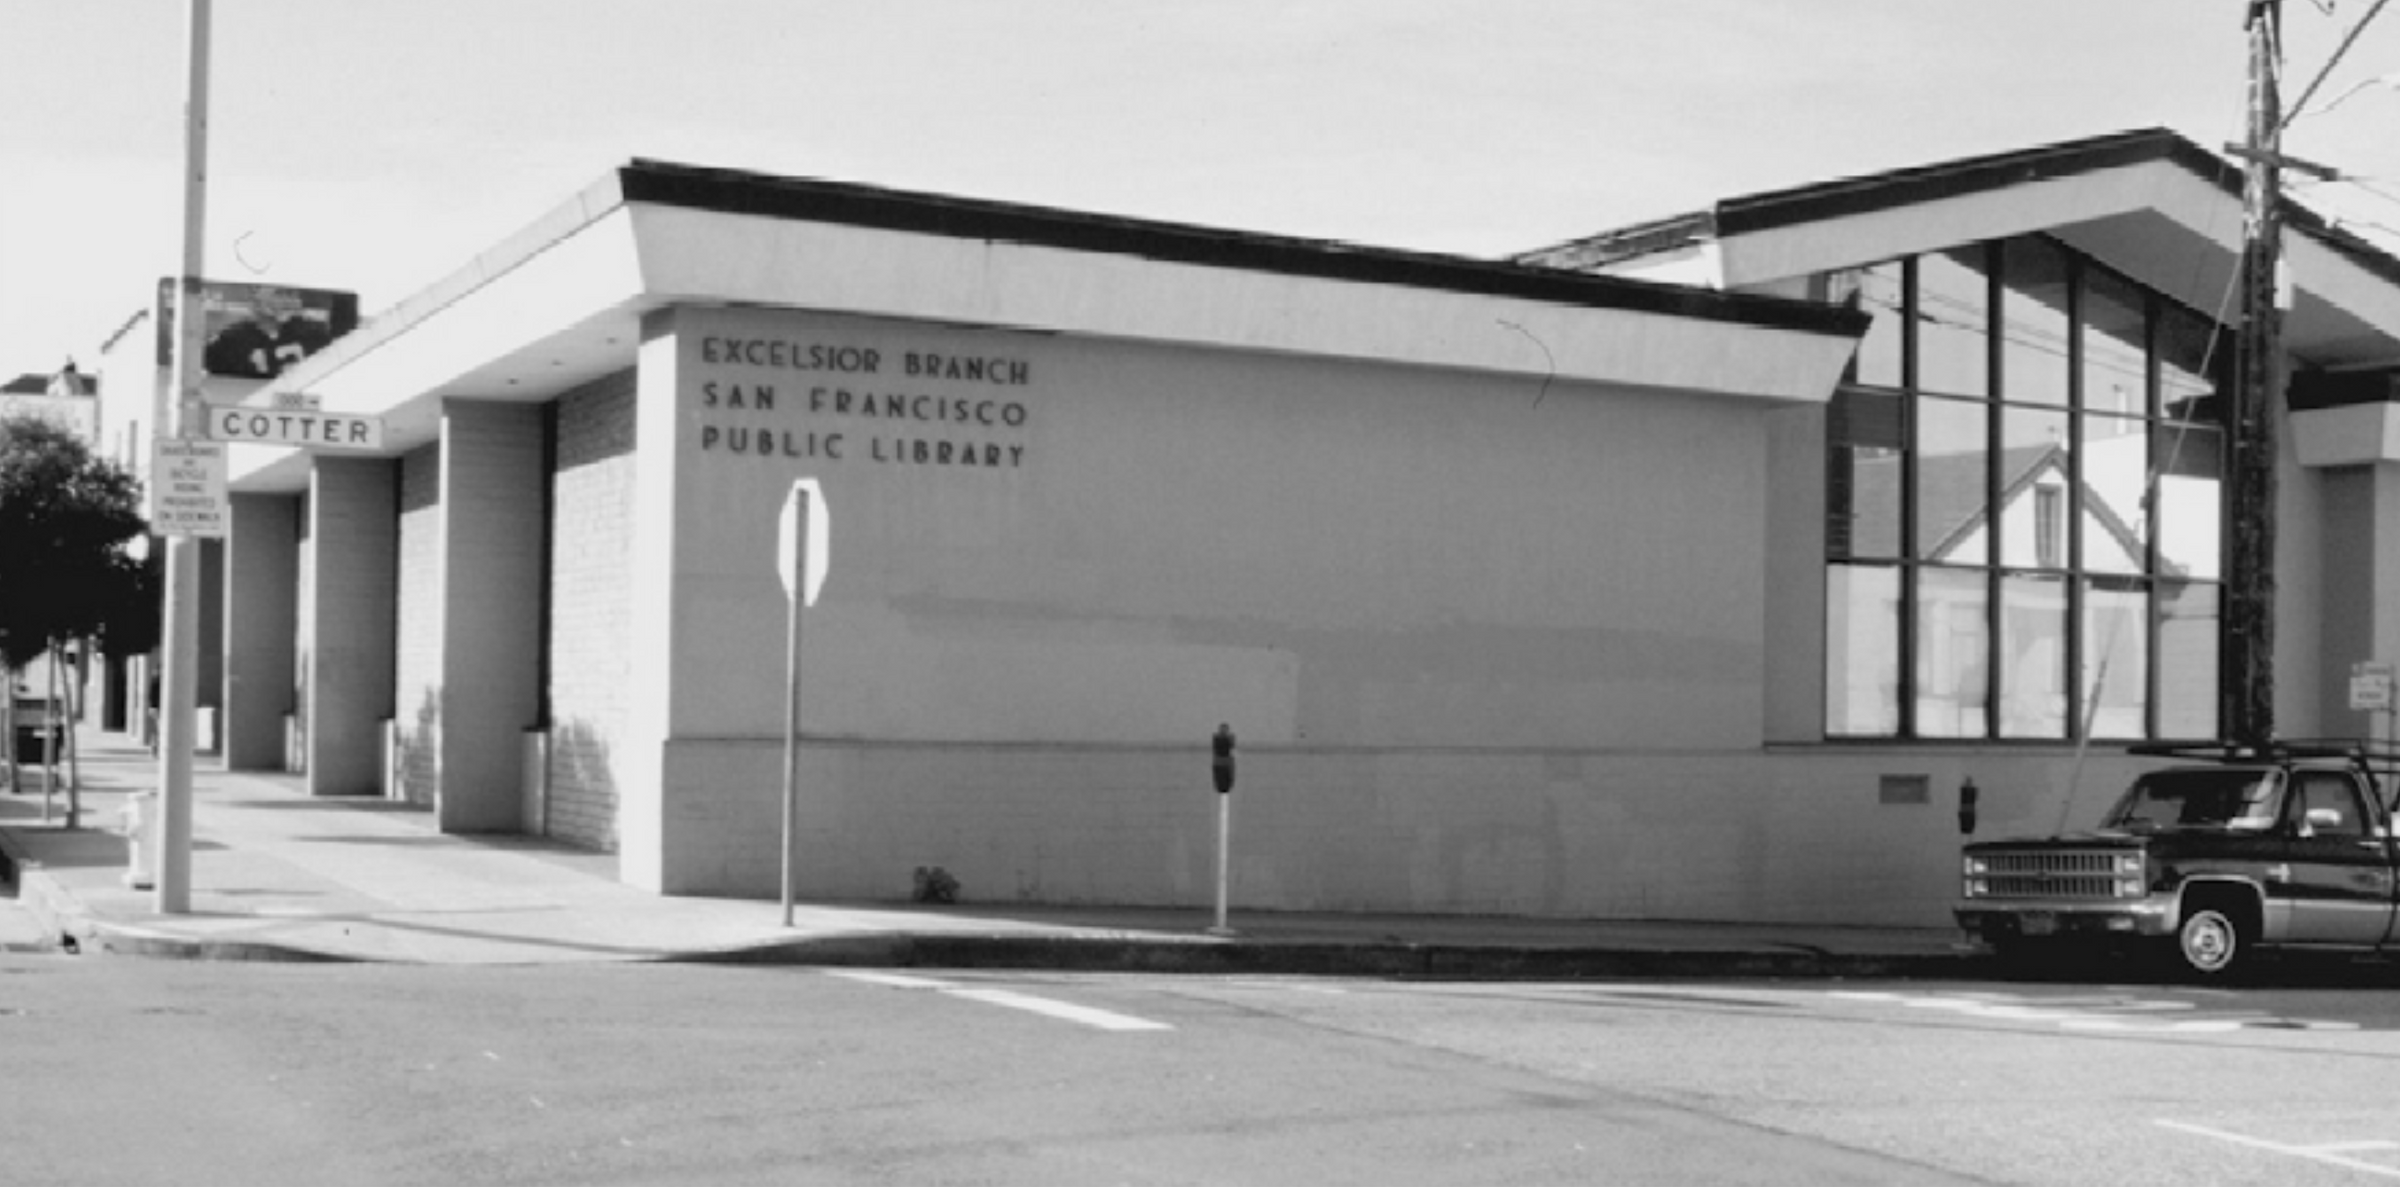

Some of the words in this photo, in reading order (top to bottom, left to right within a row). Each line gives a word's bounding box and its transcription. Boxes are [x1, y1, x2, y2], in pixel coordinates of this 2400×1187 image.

[702, 337, 881, 374] EXCELSIOR
[904, 351, 1029, 385] BRANCH
[702, 382, 775, 411] SAN
[810, 387, 1028, 427] FRANCISCO
[222, 412, 368, 443] COTTER
[702, 425, 844, 460] PUBLIC
[871, 437, 1025, 467] LIBRARY
